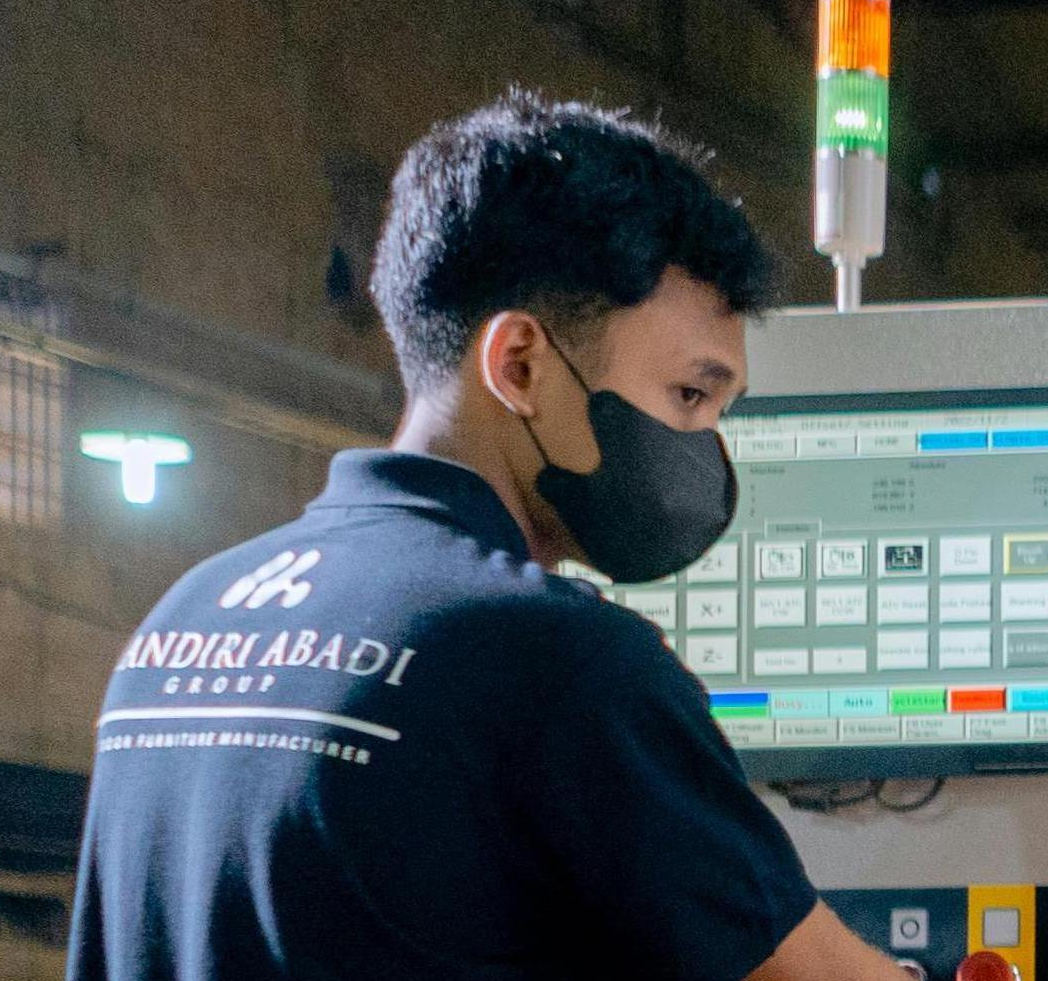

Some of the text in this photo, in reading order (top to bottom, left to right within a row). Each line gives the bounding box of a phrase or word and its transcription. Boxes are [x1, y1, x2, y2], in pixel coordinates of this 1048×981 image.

[700, 603, 722, 618] X+
[116, 629, 417, 687] ANDIRI ABADI
[163, 673, 276, 695] GROUP
[218, 730, 371, 766] MANUFACTURER
